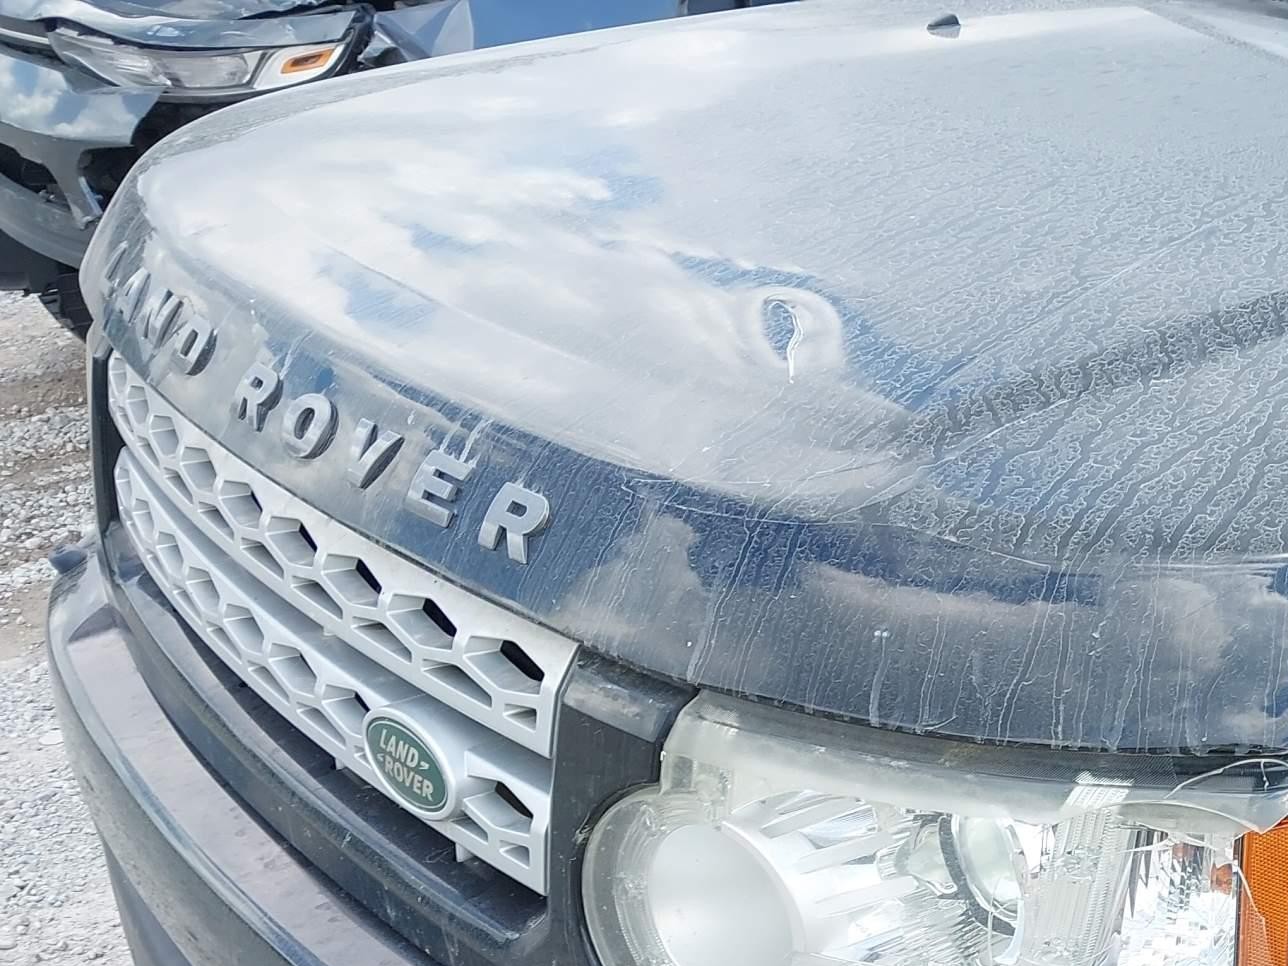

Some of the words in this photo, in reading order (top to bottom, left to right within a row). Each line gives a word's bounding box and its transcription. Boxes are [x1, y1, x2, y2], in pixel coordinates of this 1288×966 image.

[105, 241, 216, 375] LAND
[235, 365, 550, 564] ROVER
[380, 729, 419, 767] LAND
[385, 755, 433, 801] ROVER
